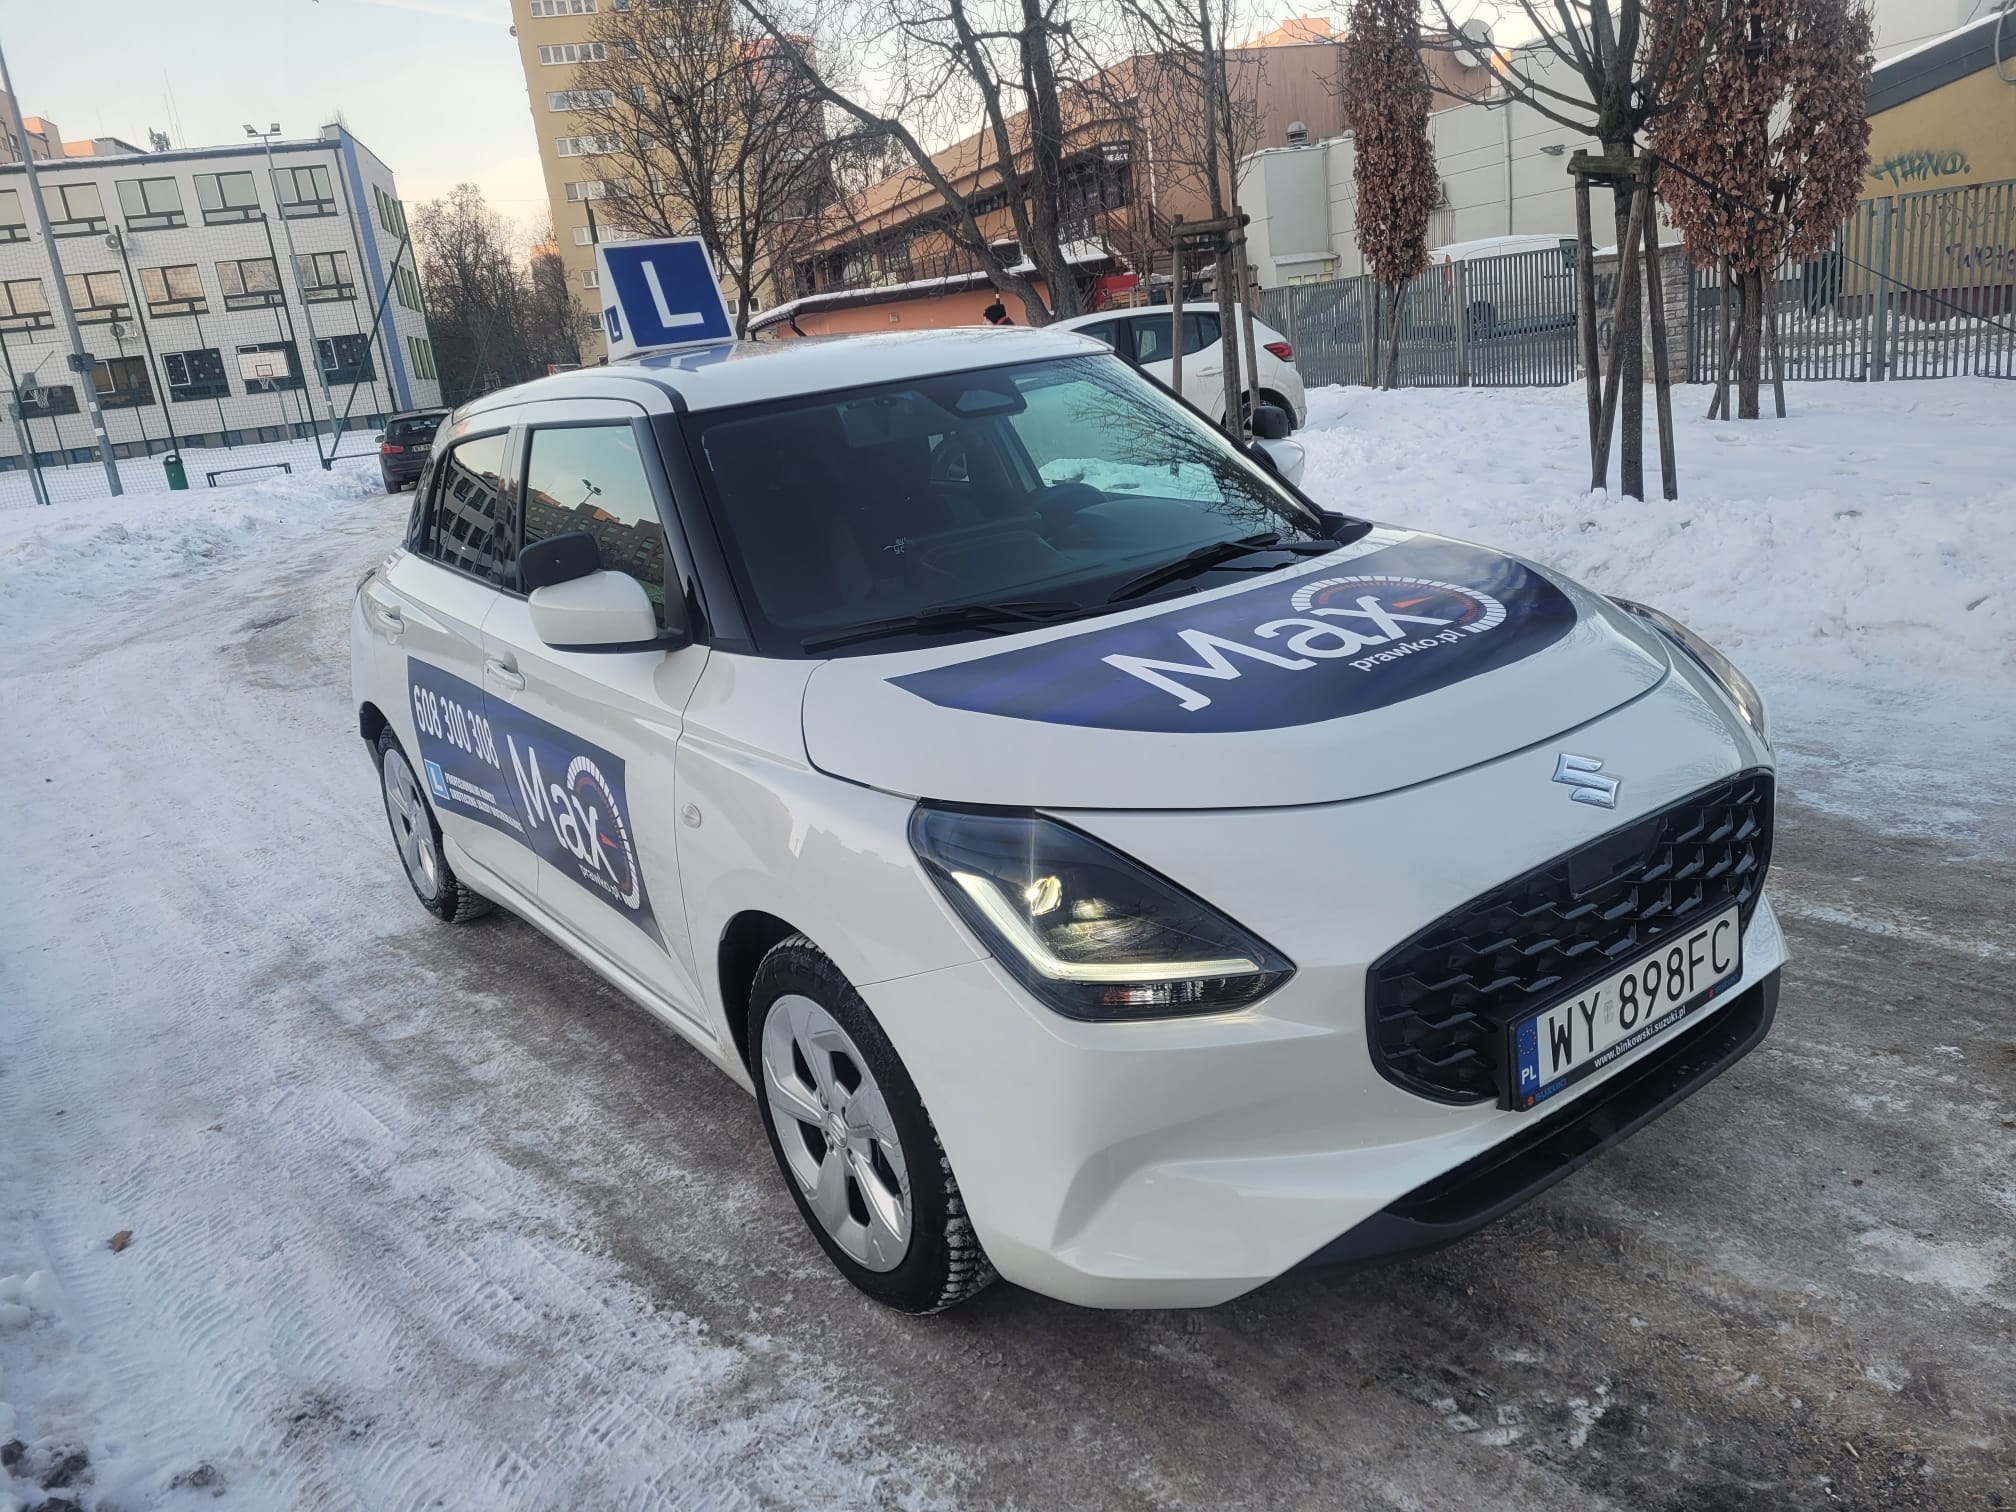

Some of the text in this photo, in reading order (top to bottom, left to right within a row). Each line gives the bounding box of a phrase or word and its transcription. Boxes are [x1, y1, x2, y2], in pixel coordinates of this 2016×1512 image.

[608, 313, 620, 337] L
[641, 260, 705, 328] L
[1100, 595, 1455, 712] Max
[1348, 629, 1467, 672] prawko.pl
[413, 684, 500, 770] 608 300 308
[429, 767, 445, 792] L
[506, 734, 620, 884] Max
[1549, 919, 1731, 1073] WY 898FC
[1593, 1005, 1687, 1069] www.binkowski.suzuki.pl
[1521, 1065, 1537, 1085] PL
